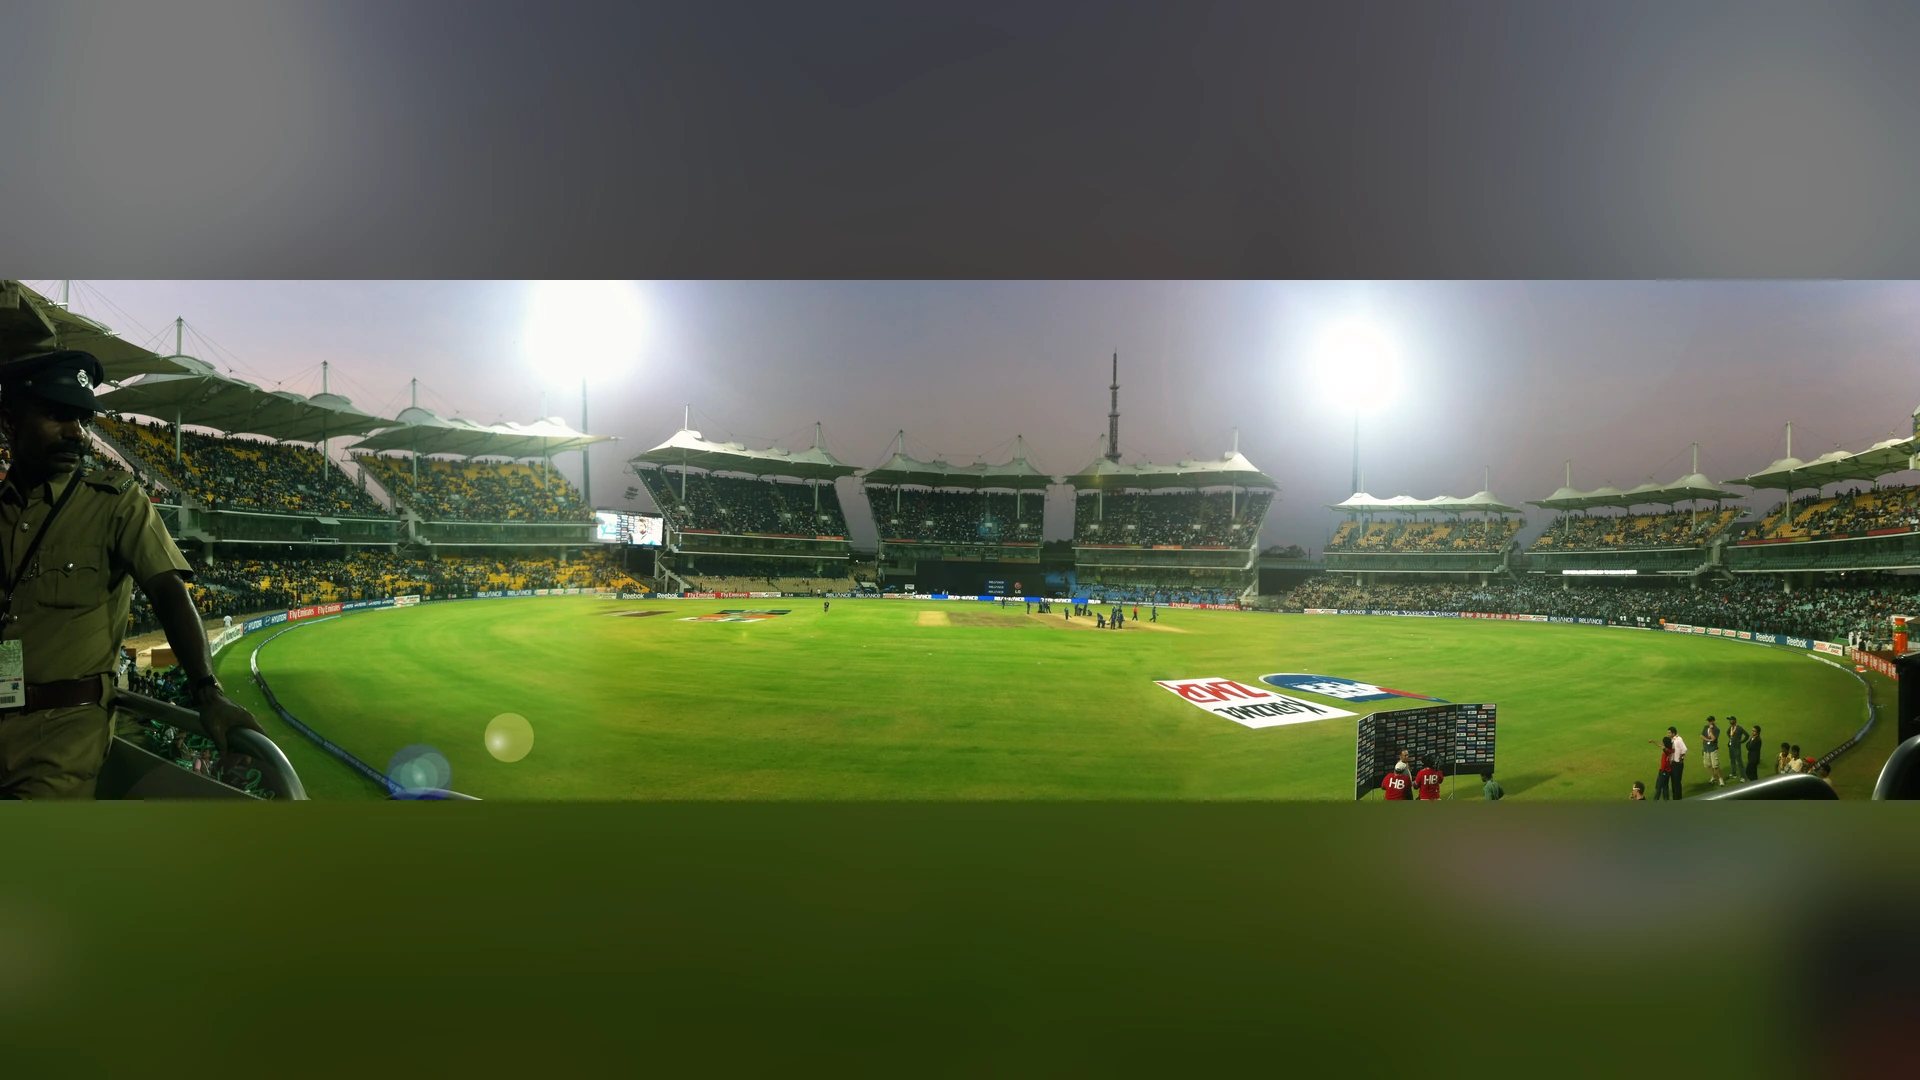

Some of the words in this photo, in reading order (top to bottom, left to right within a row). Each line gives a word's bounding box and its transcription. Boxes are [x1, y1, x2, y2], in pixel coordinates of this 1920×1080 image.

[298, 608, 314, 618] Emirates
[325, 604, 340, 613] Emirates
[1756, 632, 1776, 643] Reebok
[1786, 636, 1807, 648] Reebok
[1213, 694, 1328, 720] KARIZMA
